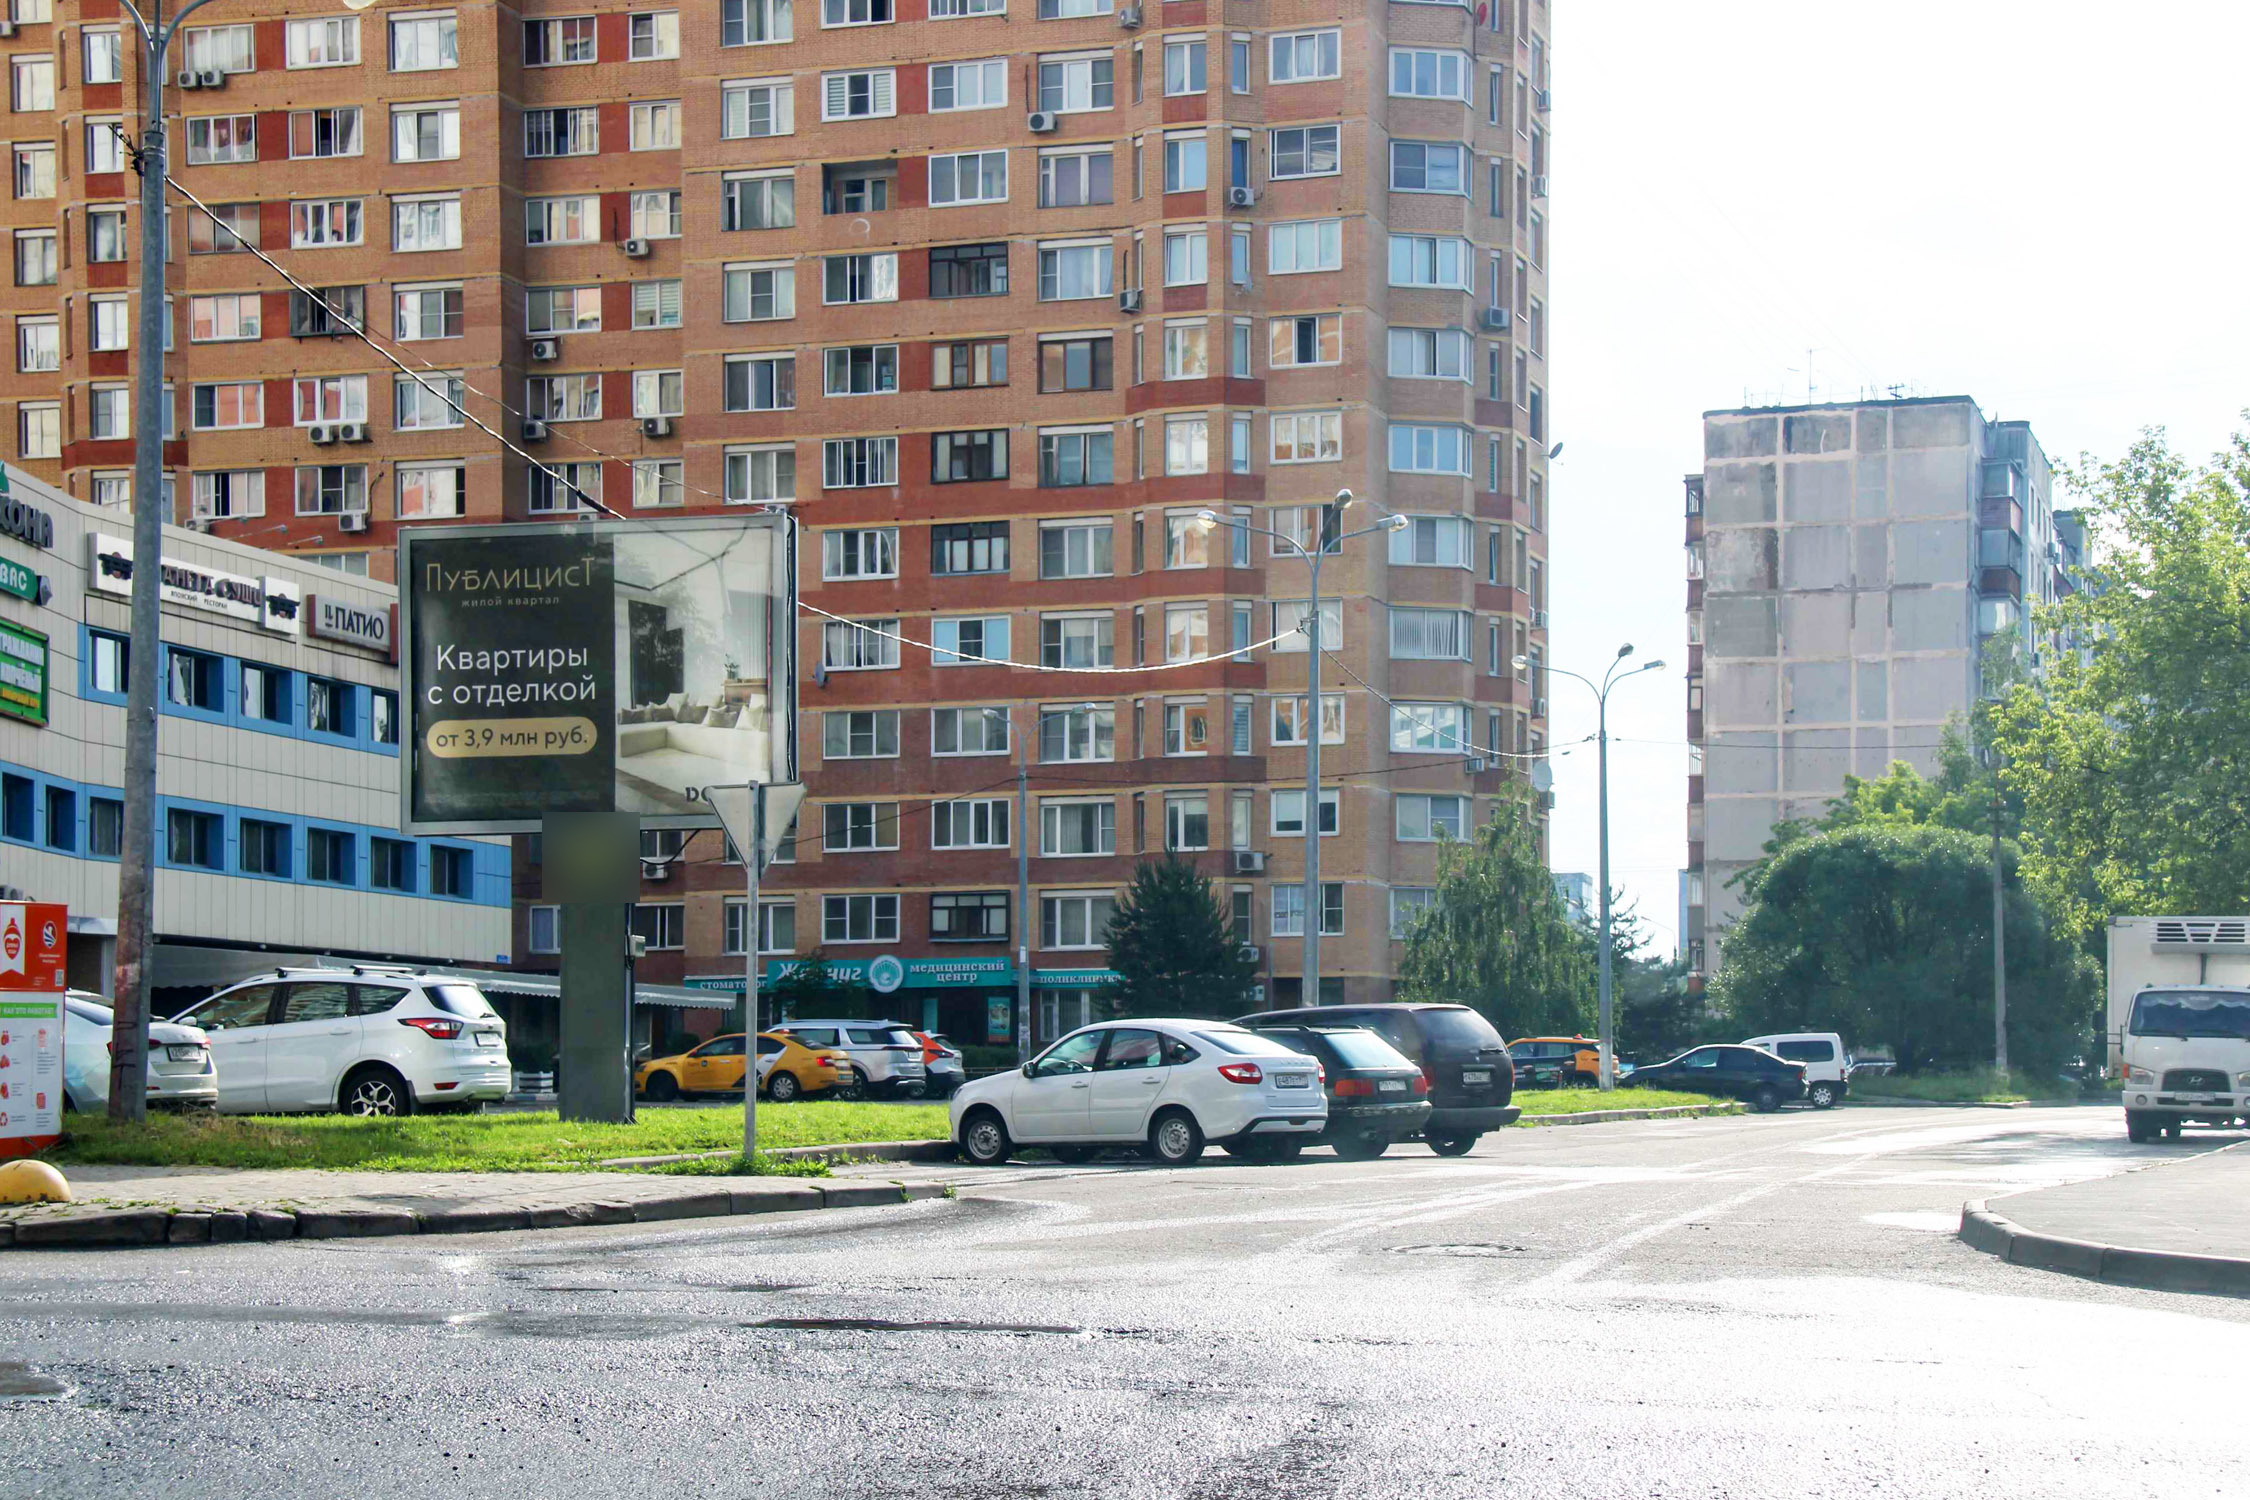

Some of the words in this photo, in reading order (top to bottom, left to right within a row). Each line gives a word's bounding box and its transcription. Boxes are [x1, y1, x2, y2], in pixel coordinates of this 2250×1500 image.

[161, 564, 214, 596] АНЕТА
[461, 596, 502, 607] жилой
[507, 596, 560, 607] квартал
[335, 606, 384, 640] ПАТИО
[437, 644, 588, 676] Квартиры
[428, 686, 443, 705] с
[453, 674, 596, 707] отделкой
[436, 734, 459, 747] от
[464, 728, 494, 750] 3,9
[500, 731, 538, 746] млн
[544, 725, 588, 749] руб.
[910, 960, 1005, 974] медицинский
[936, 972, 978, 984] центр
[700, 980, 768, 991] стоматоог
